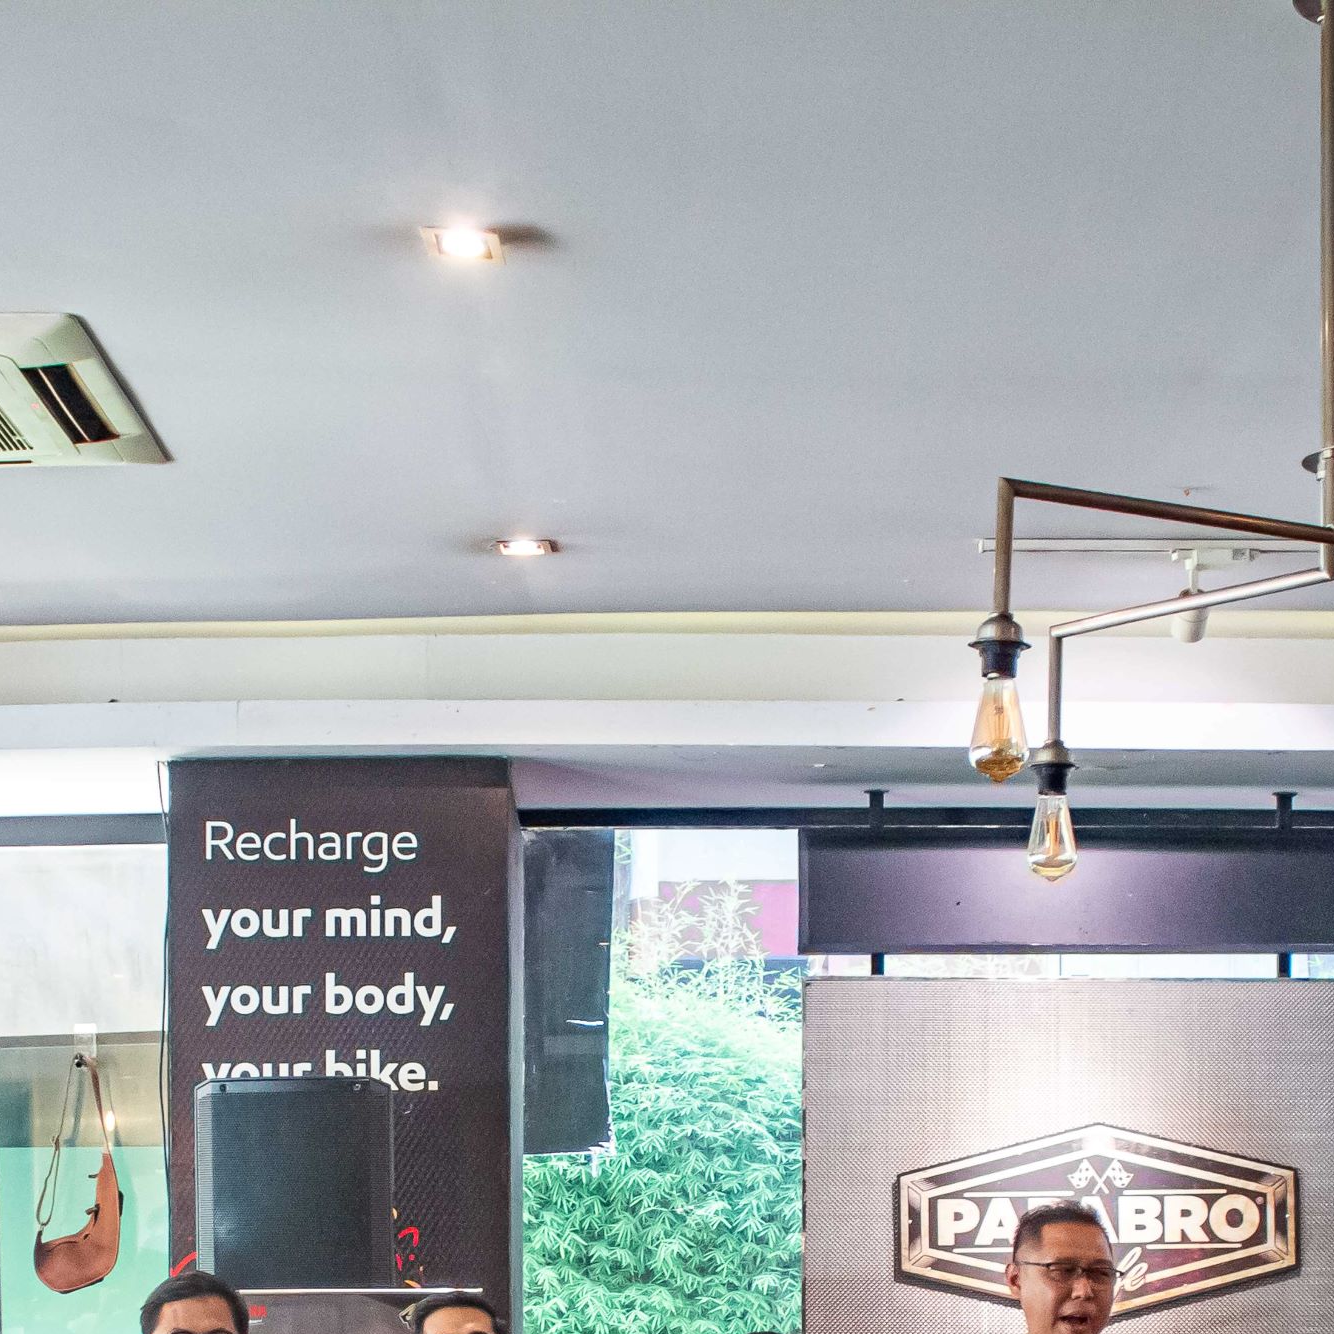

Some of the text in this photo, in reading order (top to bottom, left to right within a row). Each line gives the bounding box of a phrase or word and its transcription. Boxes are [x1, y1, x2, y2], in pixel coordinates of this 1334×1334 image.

[205, 819, 419, 872] Recharge
[202, 895, 457, 950] your mind,
[202, 972, 455, 1027] your body,
[936, 1193, 1262, 1247] PAABRO
